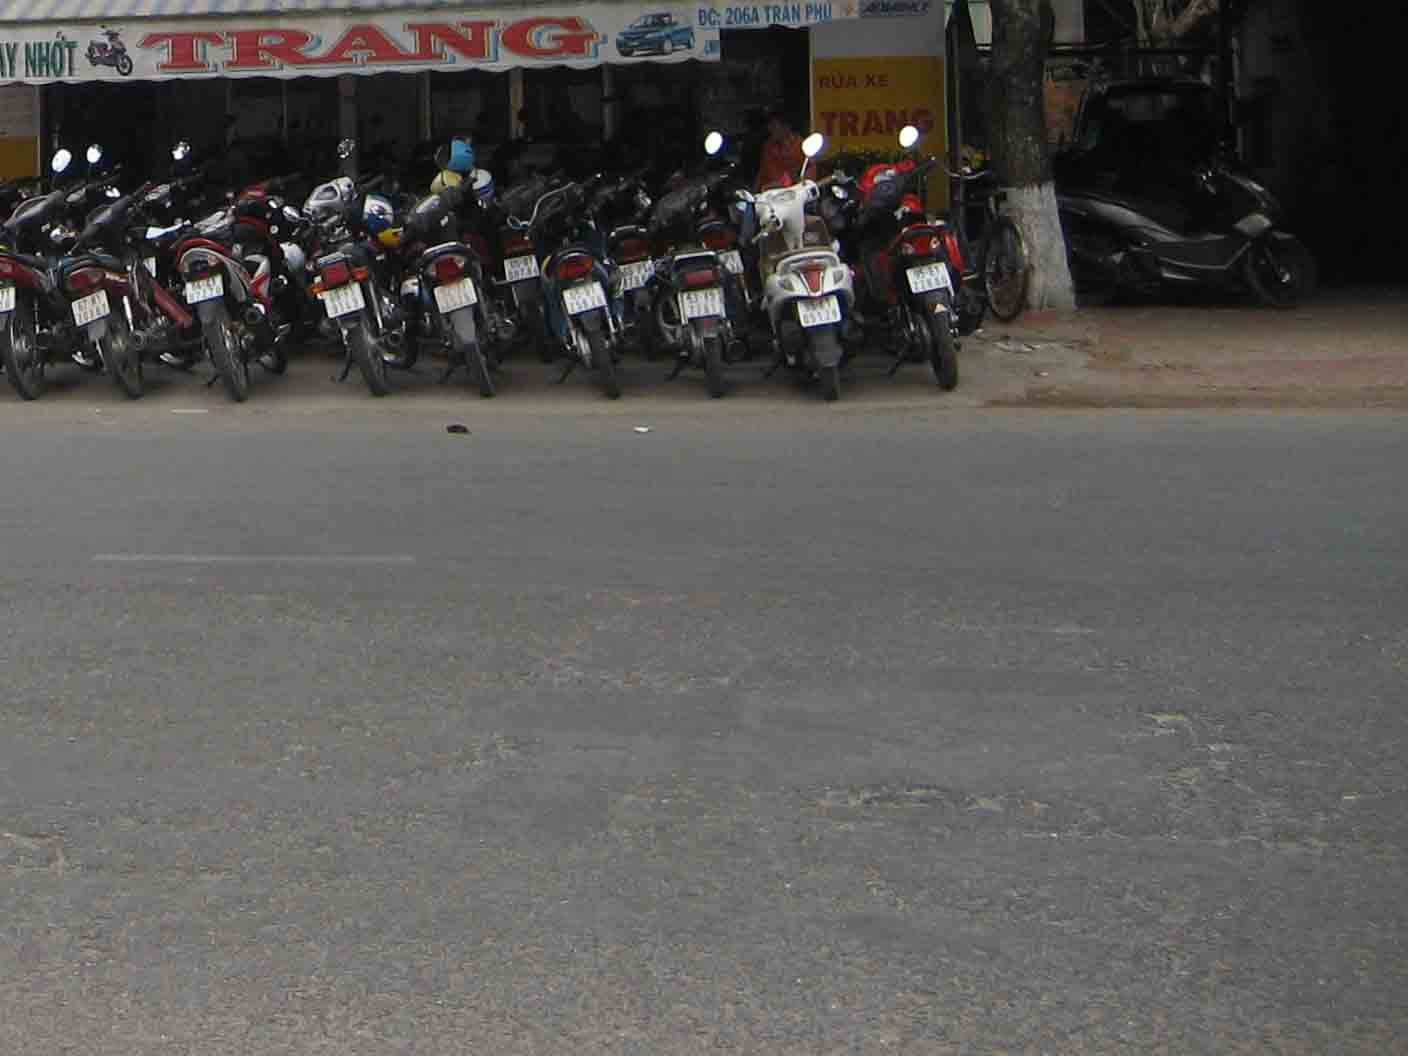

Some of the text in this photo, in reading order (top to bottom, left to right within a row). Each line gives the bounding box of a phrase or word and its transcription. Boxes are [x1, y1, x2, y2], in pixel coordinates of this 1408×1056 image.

[139, 15, 604, 72] TRANG
[864, 73, 889, 88] XE
[819, 109, 934, 137] TRANG
